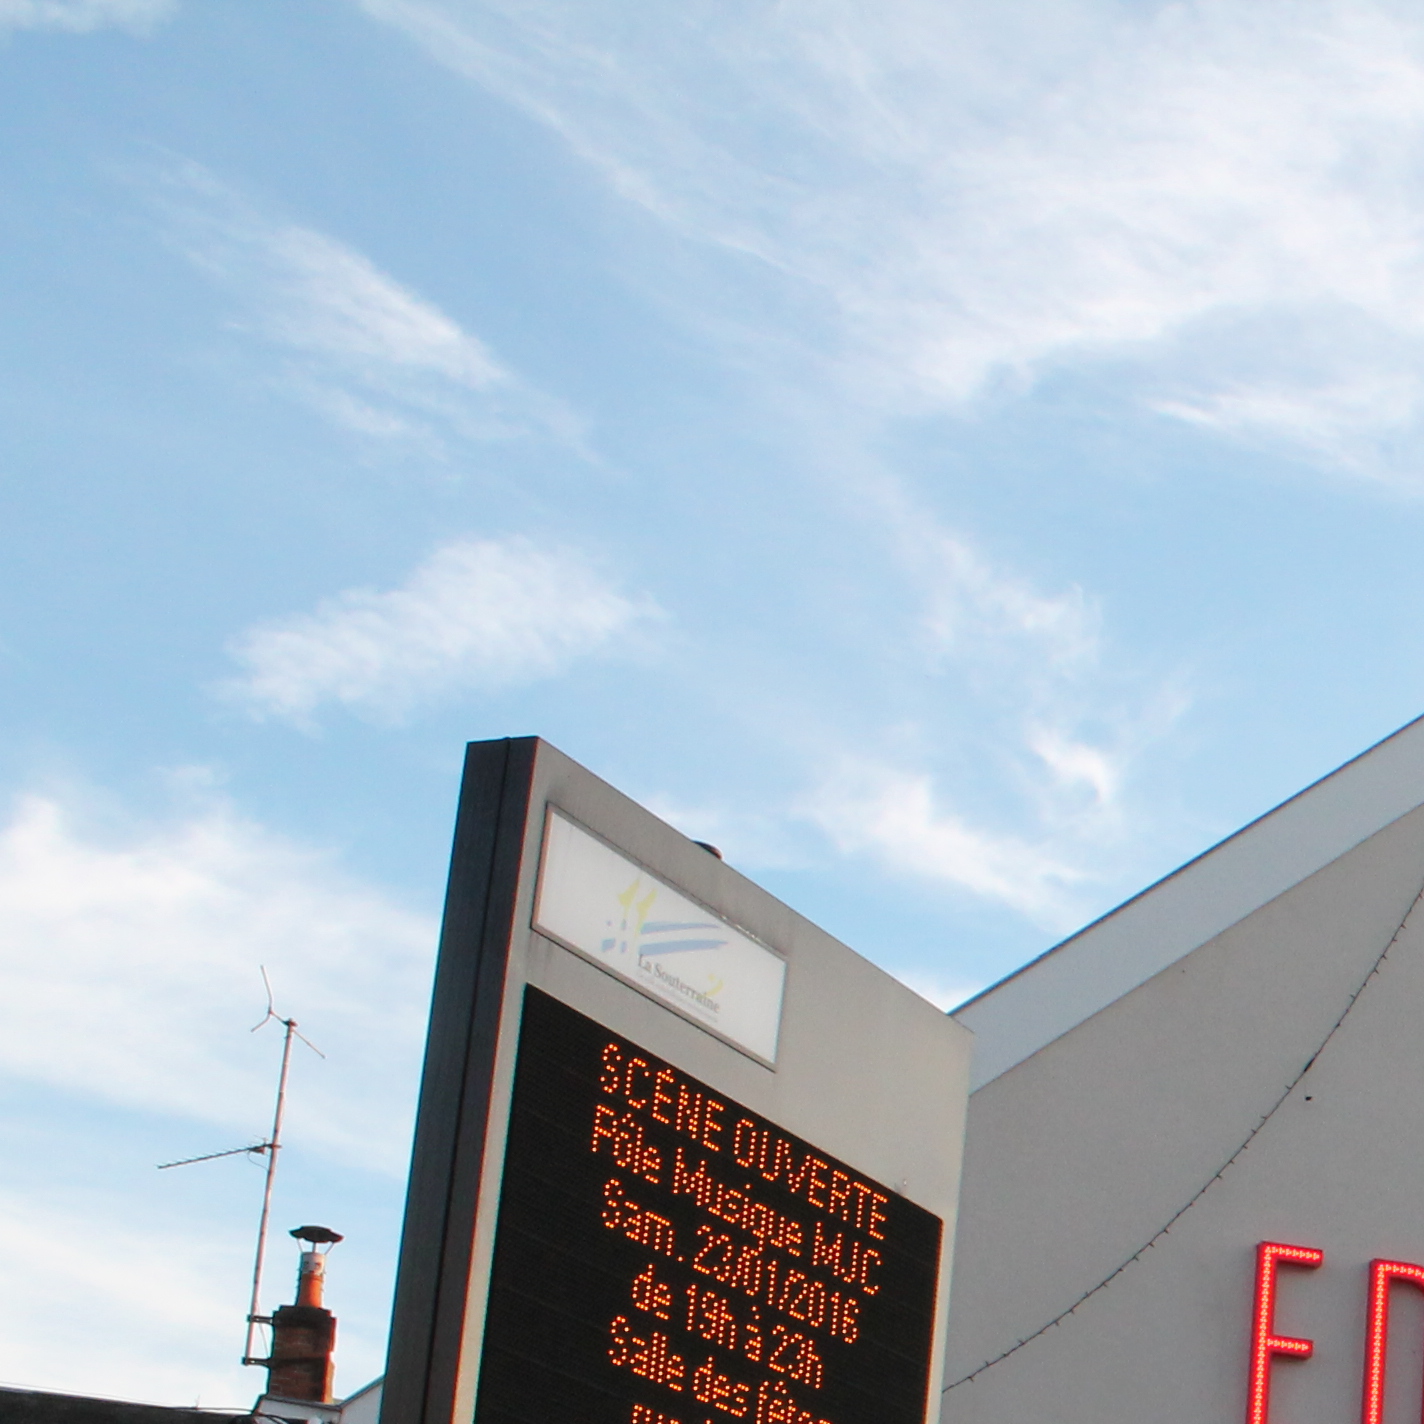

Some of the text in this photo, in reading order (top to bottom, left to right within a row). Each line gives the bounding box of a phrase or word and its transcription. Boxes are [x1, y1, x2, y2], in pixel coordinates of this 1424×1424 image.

[653, 962, 721, 1013] Souterraine
[672, 1147, 802, 1258] Musique
[811, 1220, 882, 1296] MJC
[733, 1117, 889, 1241] OUVERTE
[601, 1178, 860, 1345] Sam. 23/01/2016
[608, 1315, 685, 1392] Salle
[692, 1355, 751, 1418] des
[631, 1263, 823, 1389] de 19h à 23h
